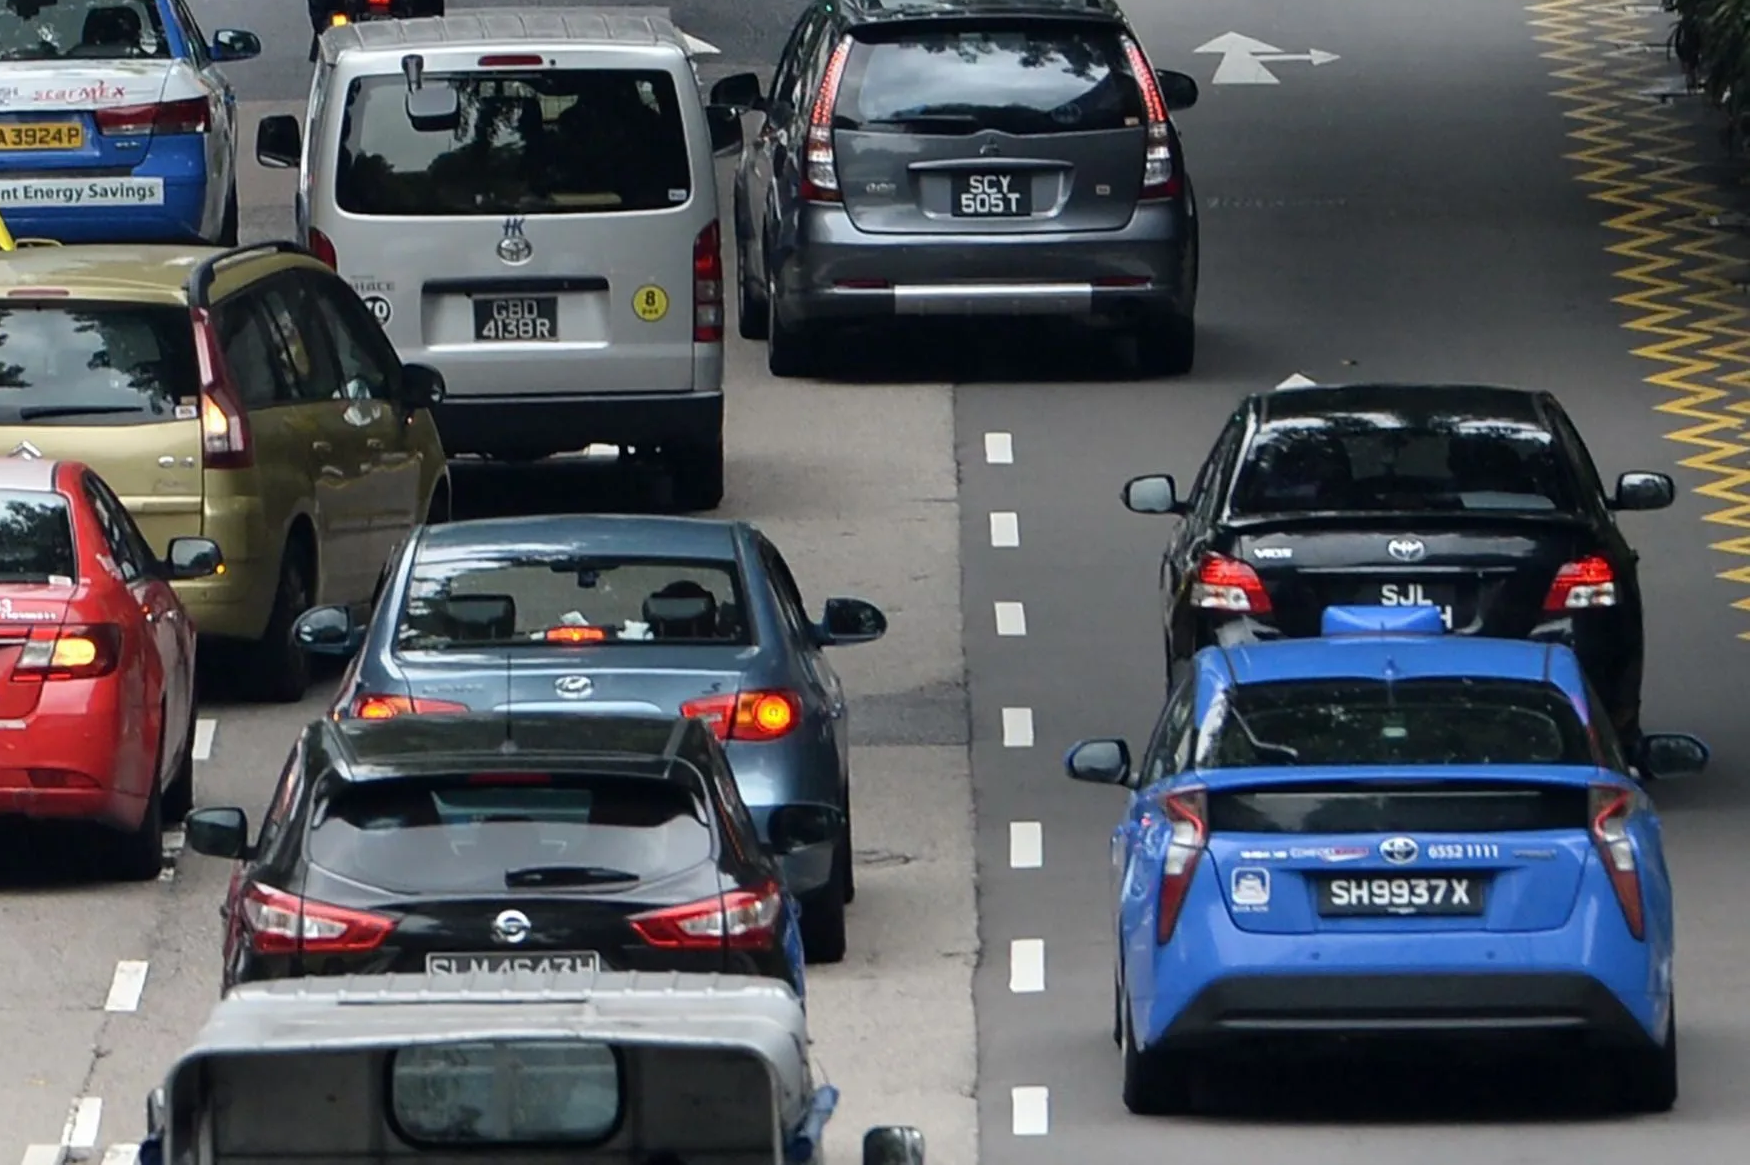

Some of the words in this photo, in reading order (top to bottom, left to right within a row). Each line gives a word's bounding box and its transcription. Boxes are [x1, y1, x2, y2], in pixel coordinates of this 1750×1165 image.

[23, 185, 83, 204] Energy
[88, 183, 156, 203] Savings
[969, 175, 1012, 194] SCY
[960, 193, 1021, 213] 505T
[645, 290, 656, 307] 8
[492, 300, 539, 320] GBD
[481, 318, 551, 339] 4138R
[1381, 584, 1433, 606] SJL
[1428, 844, 1463, 859] 6552
[1467, 844, 1499, 859] 1111
[1330, 880, 1471, 906] SH9937X
